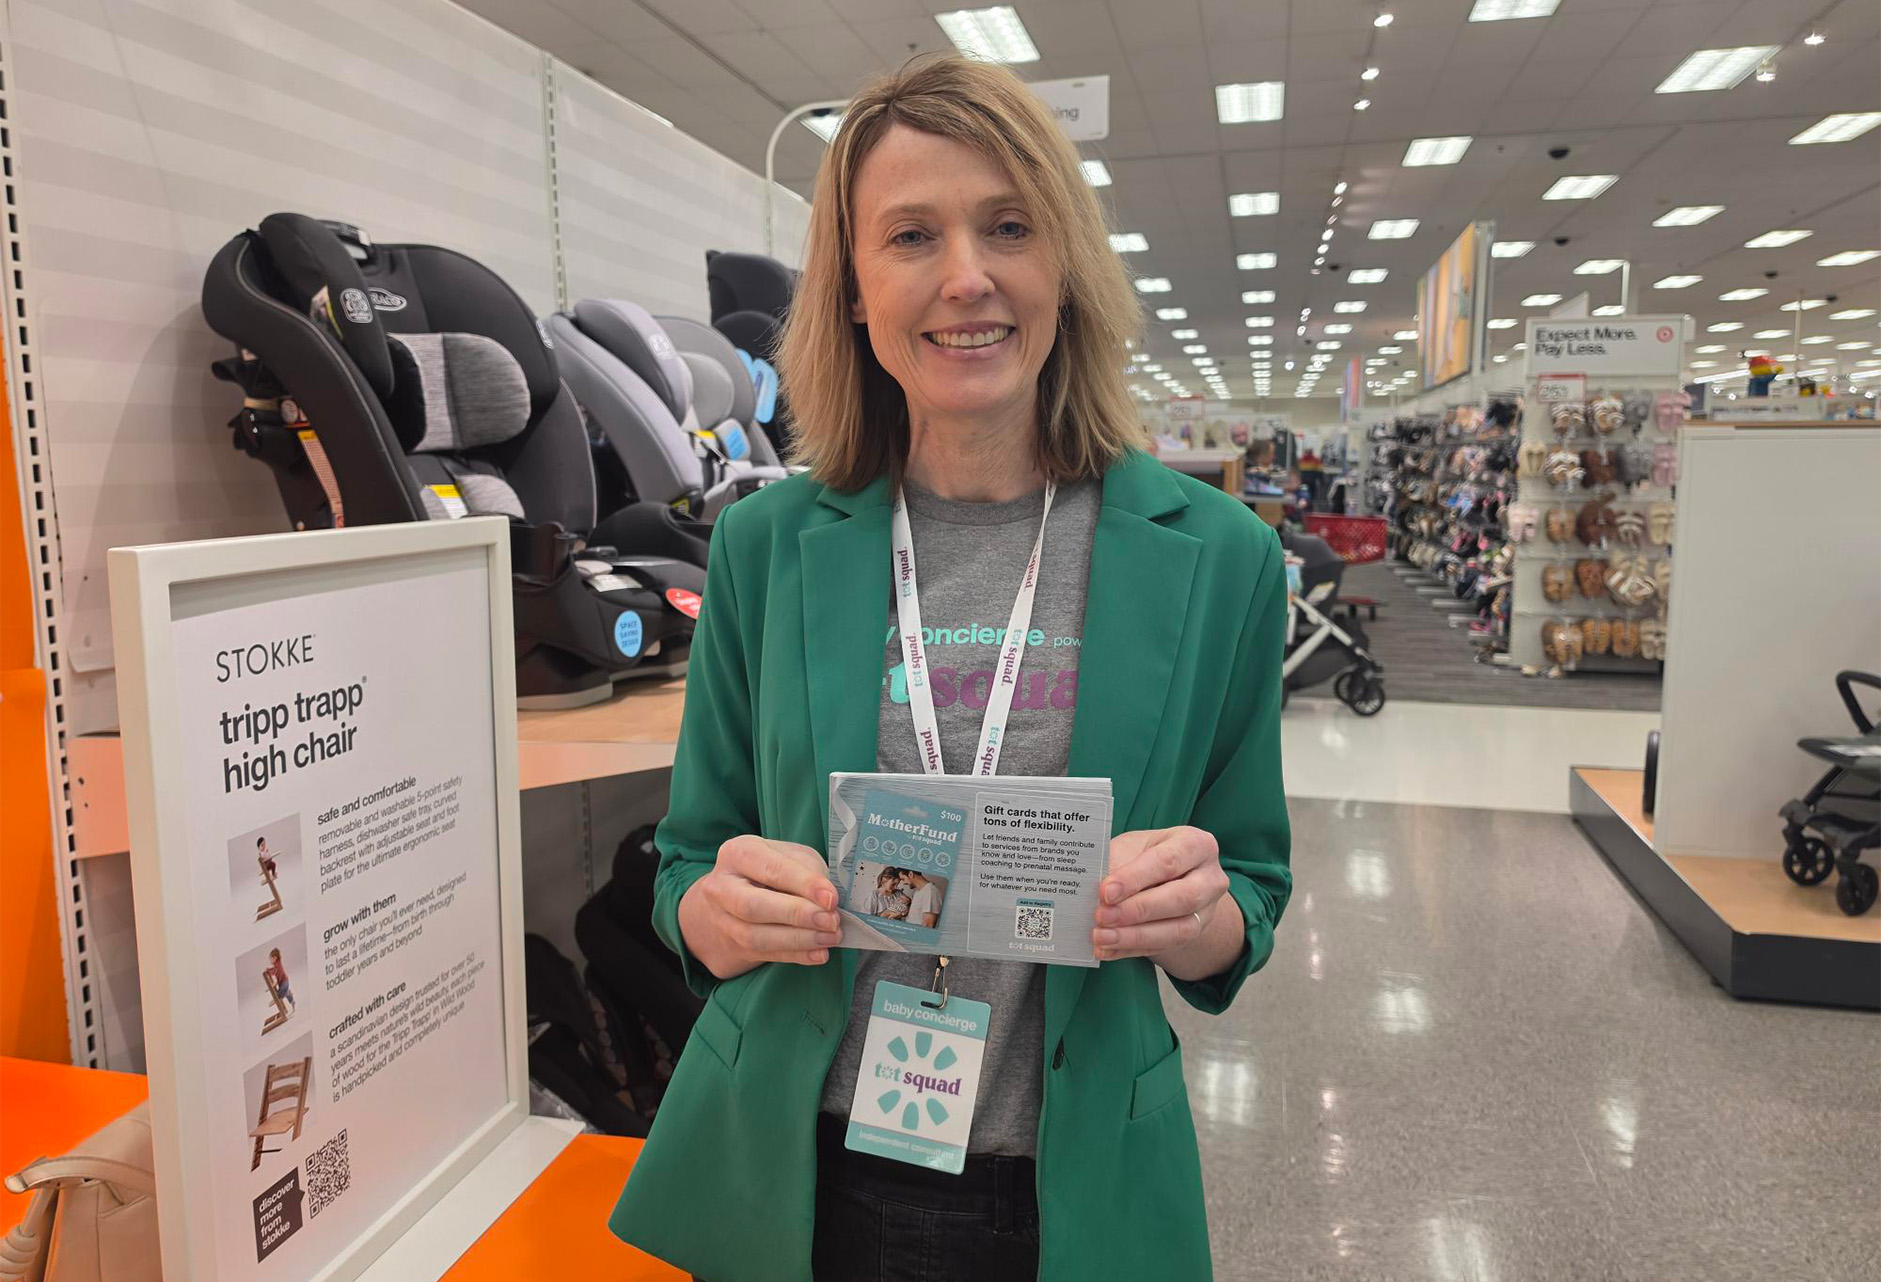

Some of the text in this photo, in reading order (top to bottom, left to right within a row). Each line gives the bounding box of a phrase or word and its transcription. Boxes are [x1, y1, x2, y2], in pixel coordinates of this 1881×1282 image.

[1535, 327, 1637, 344] Expect More.
[1535, 343, 1606, 357] Pay Less.
[901, 623, 1045, 646] onciere
[1053, 636, 1083, 649] pow
[216, 634, 315, 683] STOKKE
[930, 665, 1078, 711] squa
[219, 703, 289, 745] tripp
[223, 722, 357, 794] high chair
[981, 746, 995, 775] squa
[318, 775, 416, 826] safe and comfortable
[318, 774, 463, 845] removable and washable 5-point safety
[357, 817, 400, 844] dishwasher
[402, 808, 417, 822] safe
[434, 791, 457, 809] curved
[941, 810, 961, 822] $100
[984, 805, 1090, 822] Gift cards that offer
[320, 803, 460, 876] backrest with adjustable seat and foot
[868, 813, 958, 842] MotherFund
[984, 817, 1075, 834] tons of flexibility.
[996, 834, 1020, 842] friends
[1037, 838, 1058, 846] family
[1060, 840, 1095, 848] contribute
[321, 819, 456, 894] plate for the ultimate ergonomic seat
[981, 860, 1013, 869] coaching
[1023, 863, 1052, 871] prenatal
[991, 843, 1020, 851] services
[1040, 847, 1065, 855] brands
[991, 883, 1022, 891] whatever
[996, 874, 1014, 882] them
[323, 893, 396, 943] grow with them
[325, 945, 338, 960] the
[340, 932, 357, 952] only
[359, 922, 377, 940] chair
[399, 903, 415, 917] ever
[436, 872, 467, 900] designed
[325, 962, 334, 975] to
[336, 954, 350, 970] last
[352, 949, 358, 960] a
[411, 909, 428, 927] birth
[428, 893, 455, 918] through
[1024, 943, 1055, 953] squad
[326, 926, 422, 990] toddler years and beyond
[329, 982, 406, 1039] crafted with care
[330, 1048, 336, 1058] a
[338, 1013, 388, 1055] scandinavian
[389, 995, 414, 1019] design
[415, 977, 440, 1000] trusted
[441, 970, 450, 983] for
[451, 962, 465, 975] over
[331, 1051, 353, 1075] years
[355, 1035, 379, 1057] meets
[410, 1001, 425, 1018] wild
[450, 973, 466, 990] each
[332, 1073, 341, 1088] of
[342, 1058, 365, 1082] wood
[366, 1049, 378, 1065] for
[378, 1040, 391, 1054] the
[392, 1028, 410, 1048] Tripp
[433, 1004, 440, 1015] in
[333, 1001, 465, 1103] is handpicked and completely unique
[903, 1071, 962, 1096] squad
[259, 1178, 294, 1213] discover
[260, 1202, 282, 1225] more
[261, 1215, 282, 1238] from
[262, 1221, 291, 1250] stokke
